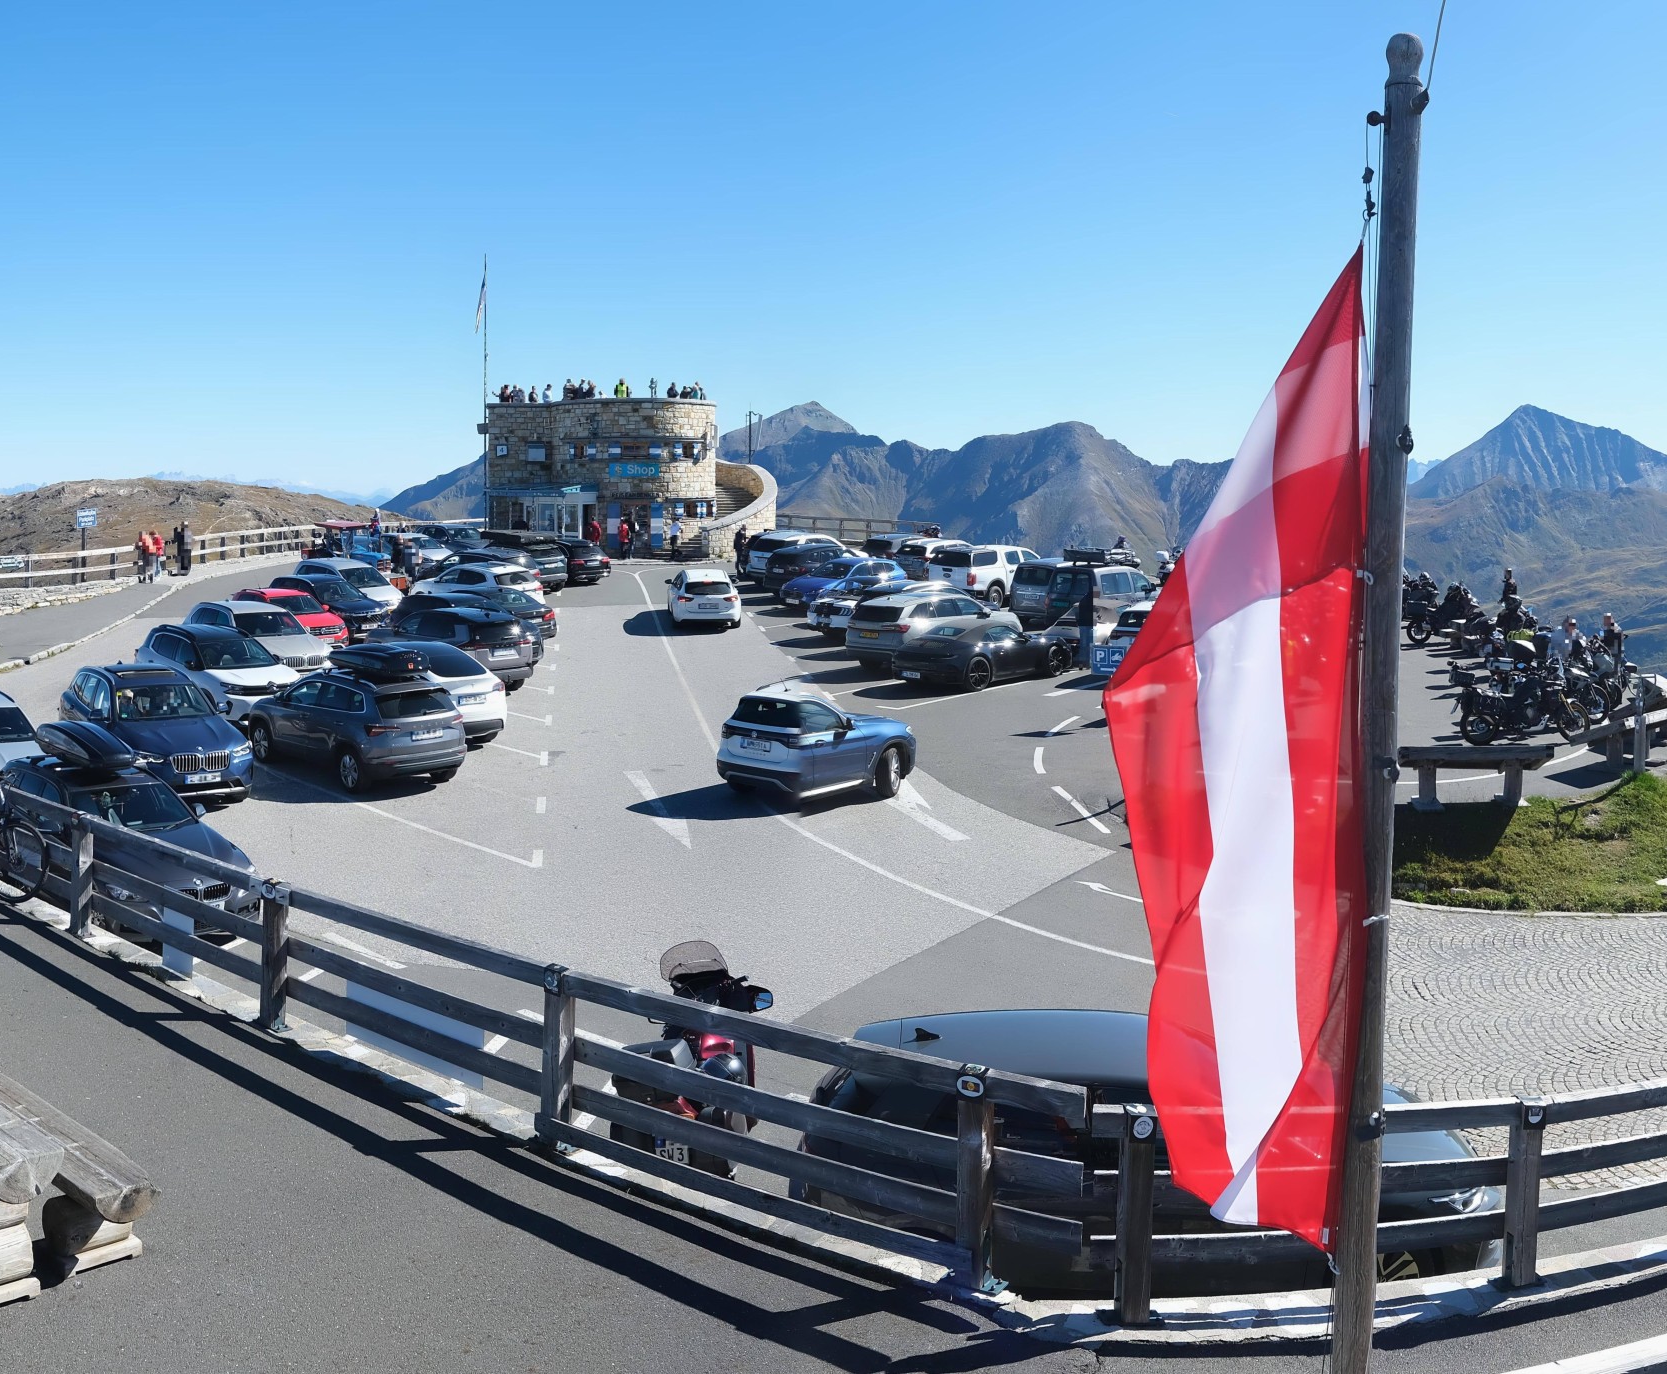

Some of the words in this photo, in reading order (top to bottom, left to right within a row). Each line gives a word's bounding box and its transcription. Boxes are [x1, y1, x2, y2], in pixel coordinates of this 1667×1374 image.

[626, 464, 655, 476] Shop
[1097, 651, 1105, 661] P
[676, 1147, 685, 1162] 3
